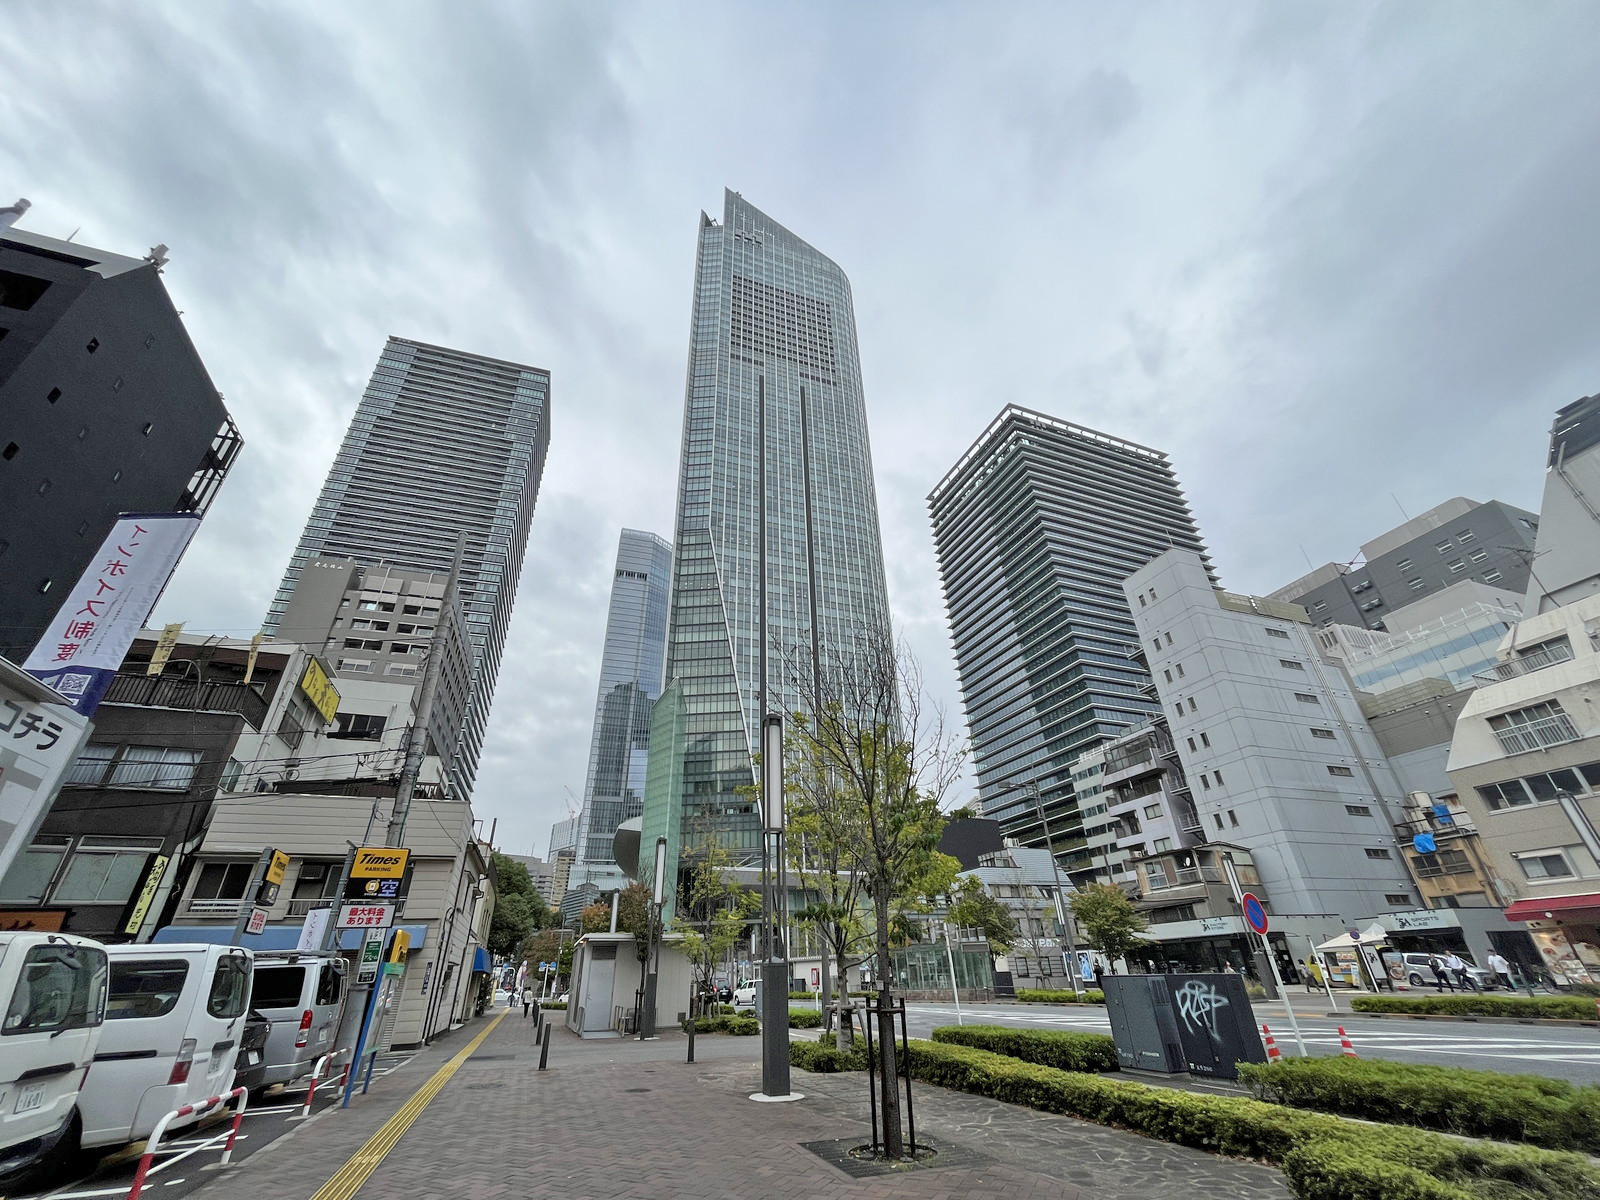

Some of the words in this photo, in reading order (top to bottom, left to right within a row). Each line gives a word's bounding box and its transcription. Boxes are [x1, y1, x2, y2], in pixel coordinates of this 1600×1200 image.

[359, 853, 402, 865] Times
[378, 880, 399, 897] 空
[348, 907, 385, 917] 最大料金
[346, 916, 384, 925] あります
